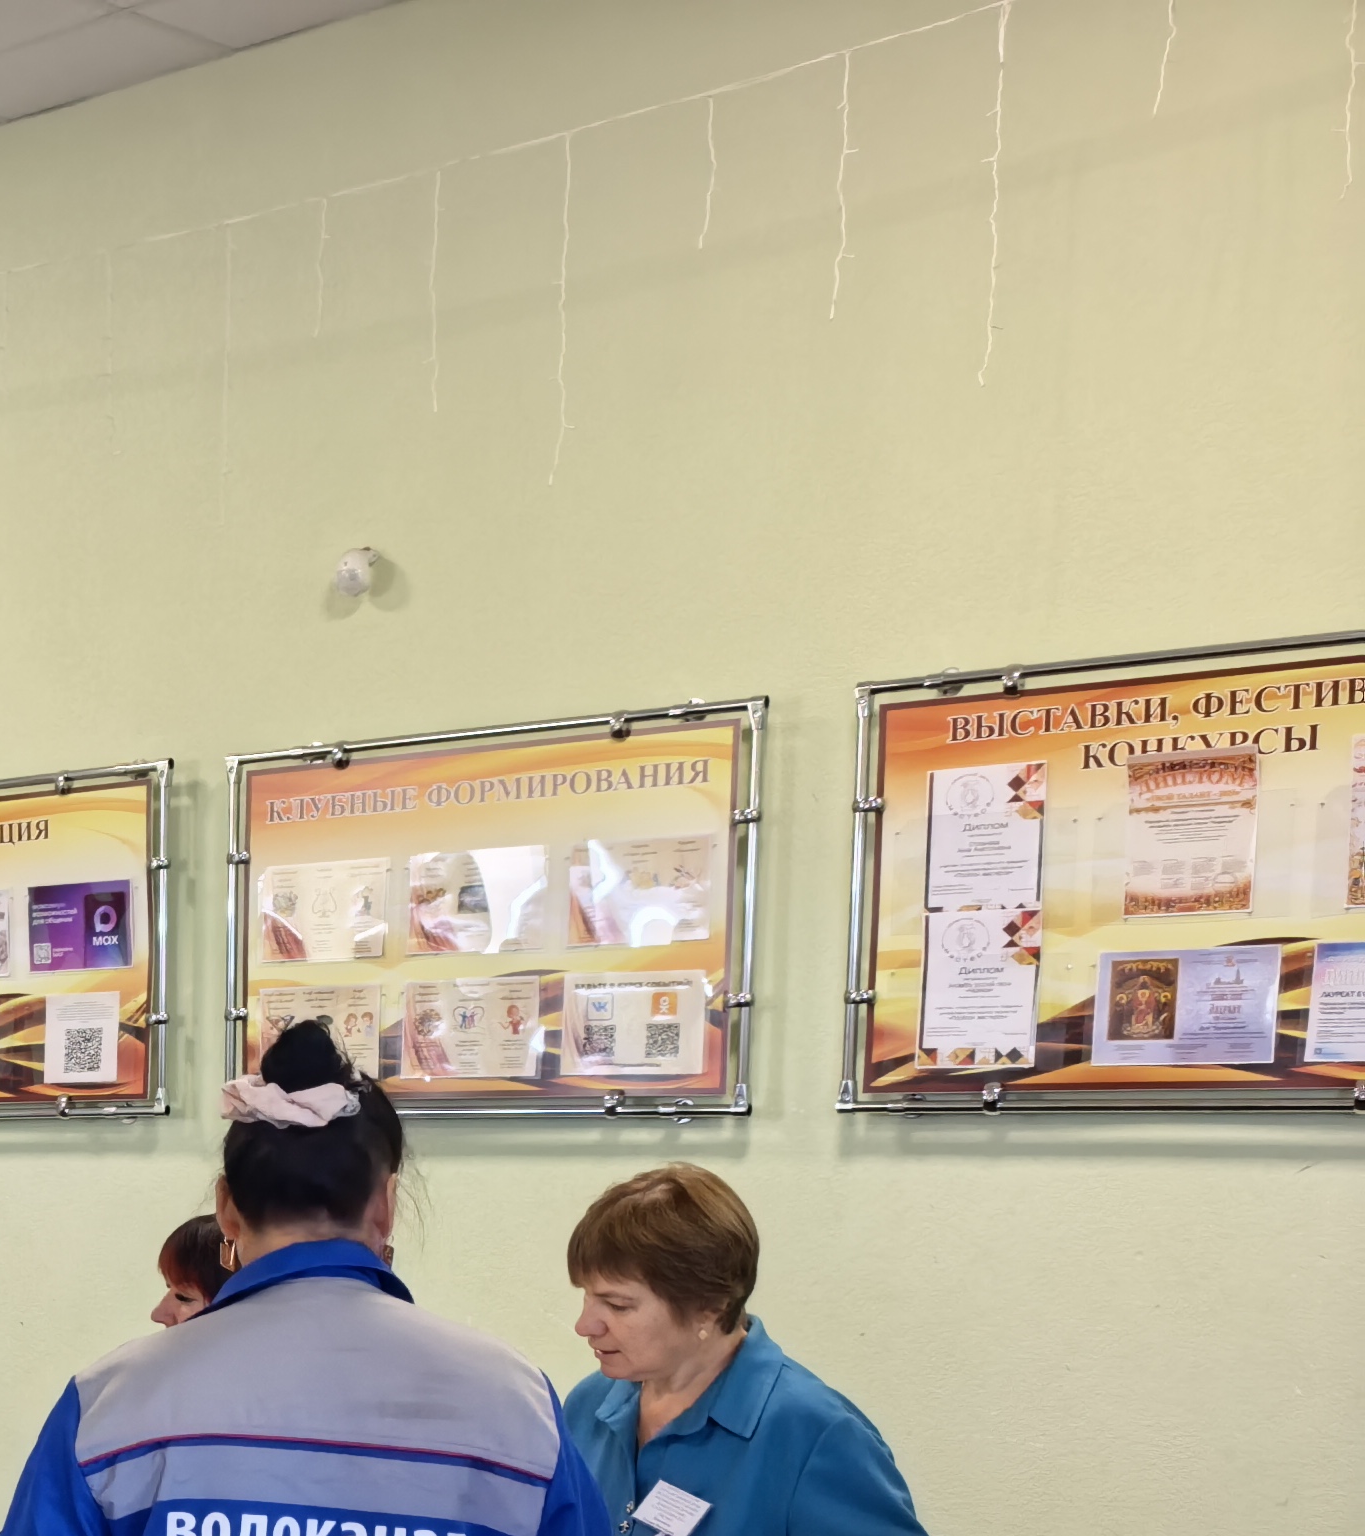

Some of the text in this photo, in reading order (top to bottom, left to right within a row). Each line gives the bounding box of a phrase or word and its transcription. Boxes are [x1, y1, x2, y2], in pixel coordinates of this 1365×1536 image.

[949, 677, 1365, 742] ВЫСТАВКИ, ФЕСТИВ
[267, 758, 710, 822] КЛУБНЫЕ ФОРМИРОВАНИЯ
